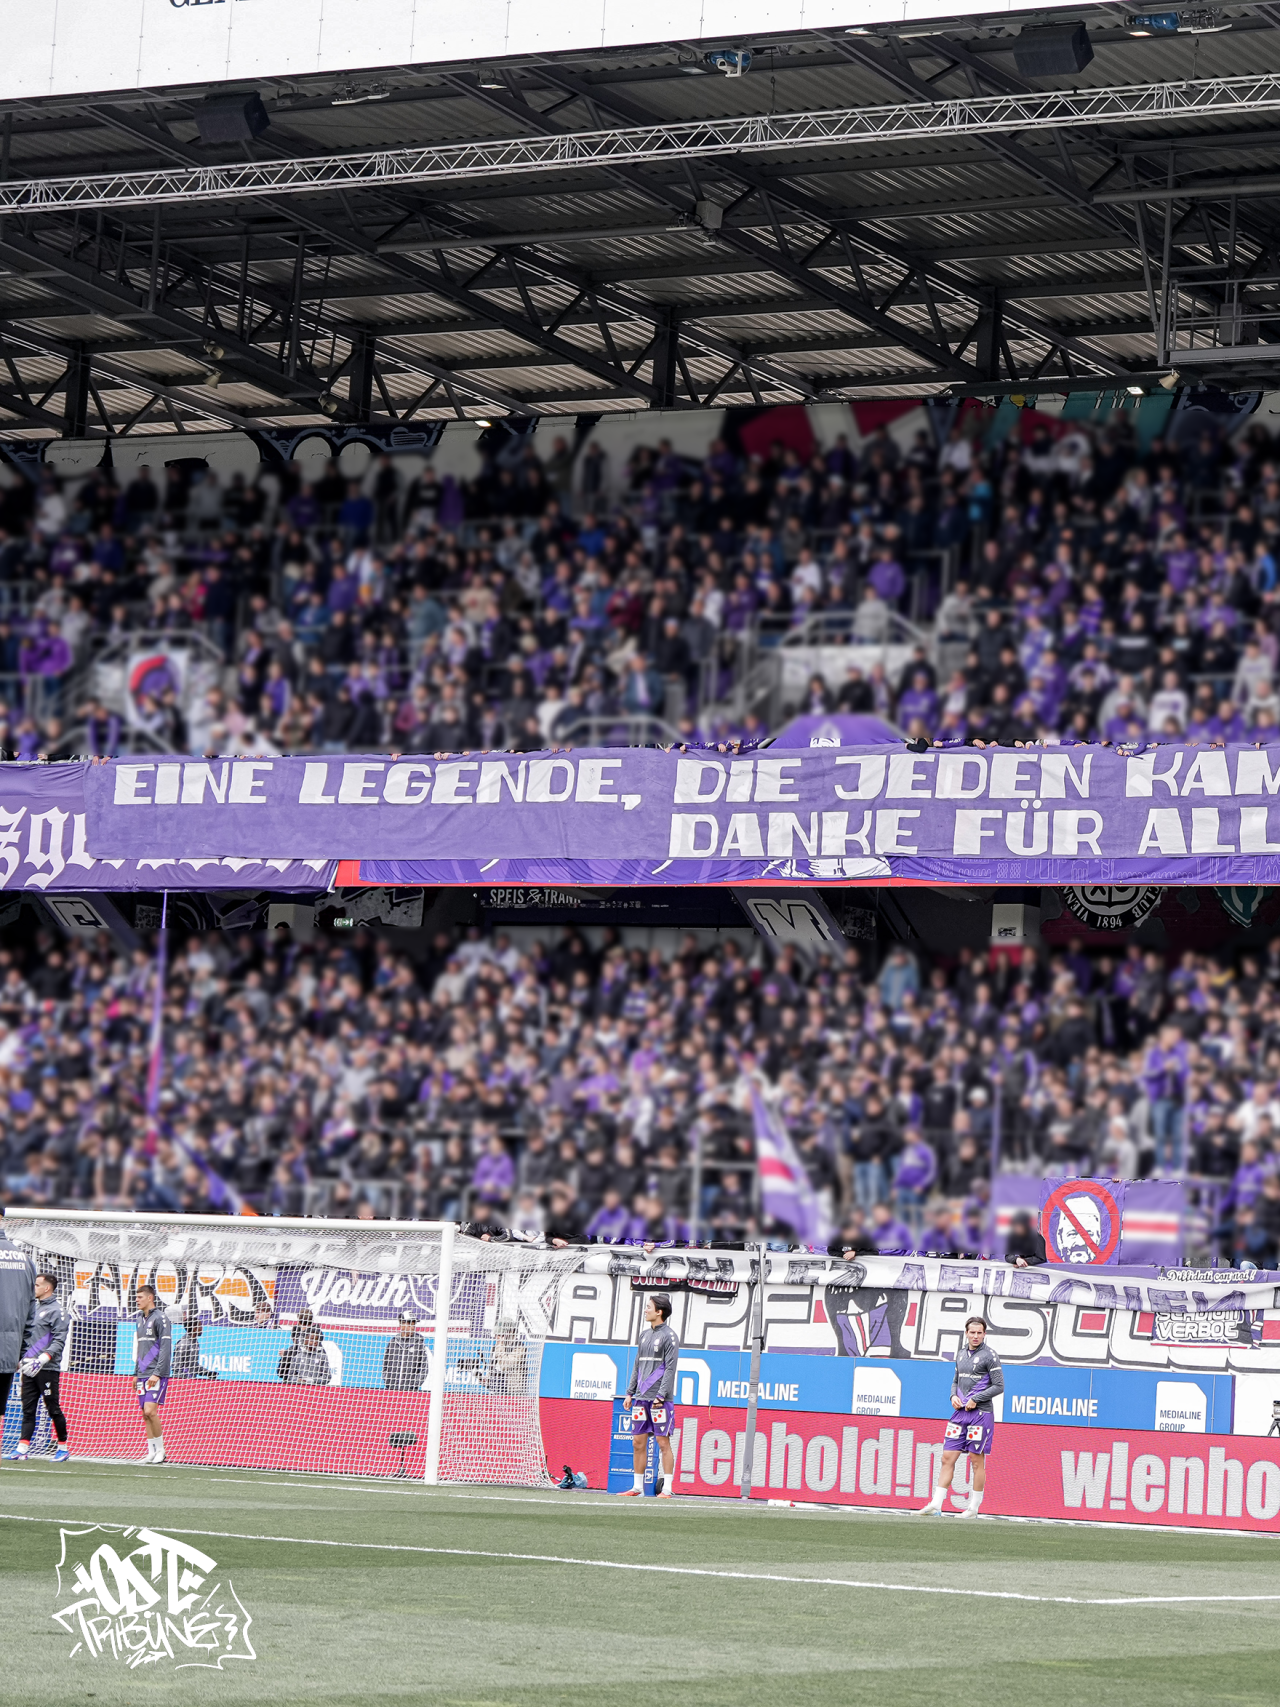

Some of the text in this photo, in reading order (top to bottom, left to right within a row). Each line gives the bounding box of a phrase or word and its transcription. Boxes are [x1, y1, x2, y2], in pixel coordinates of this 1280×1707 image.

[114, 762, 273, 804] EINE
[299, 759, 642, 810] LEGENDE,
[674, 759, 800, 803] DIE
[834, 753, 1094, 800] JEDEN
[669, 811, 921, 857] DANKE
[953, 799, 1102, 856] FÜR
[490, 889, 525, 904] SPEIS
[1096, 915, 1123, 928] 1894
[574, 1380, 613, 1391] MEDIALINE
[717, 1380, 800, 1402] MEDALINE
[856, 1394, 896, 1405] MEDIALINE
[1011, 1395, 1099, 1418] MEDIALINE
[1159, 1409, 1202, 1421] MEDIALINE
[1159, 1423, 1186, 1432] GROUP
